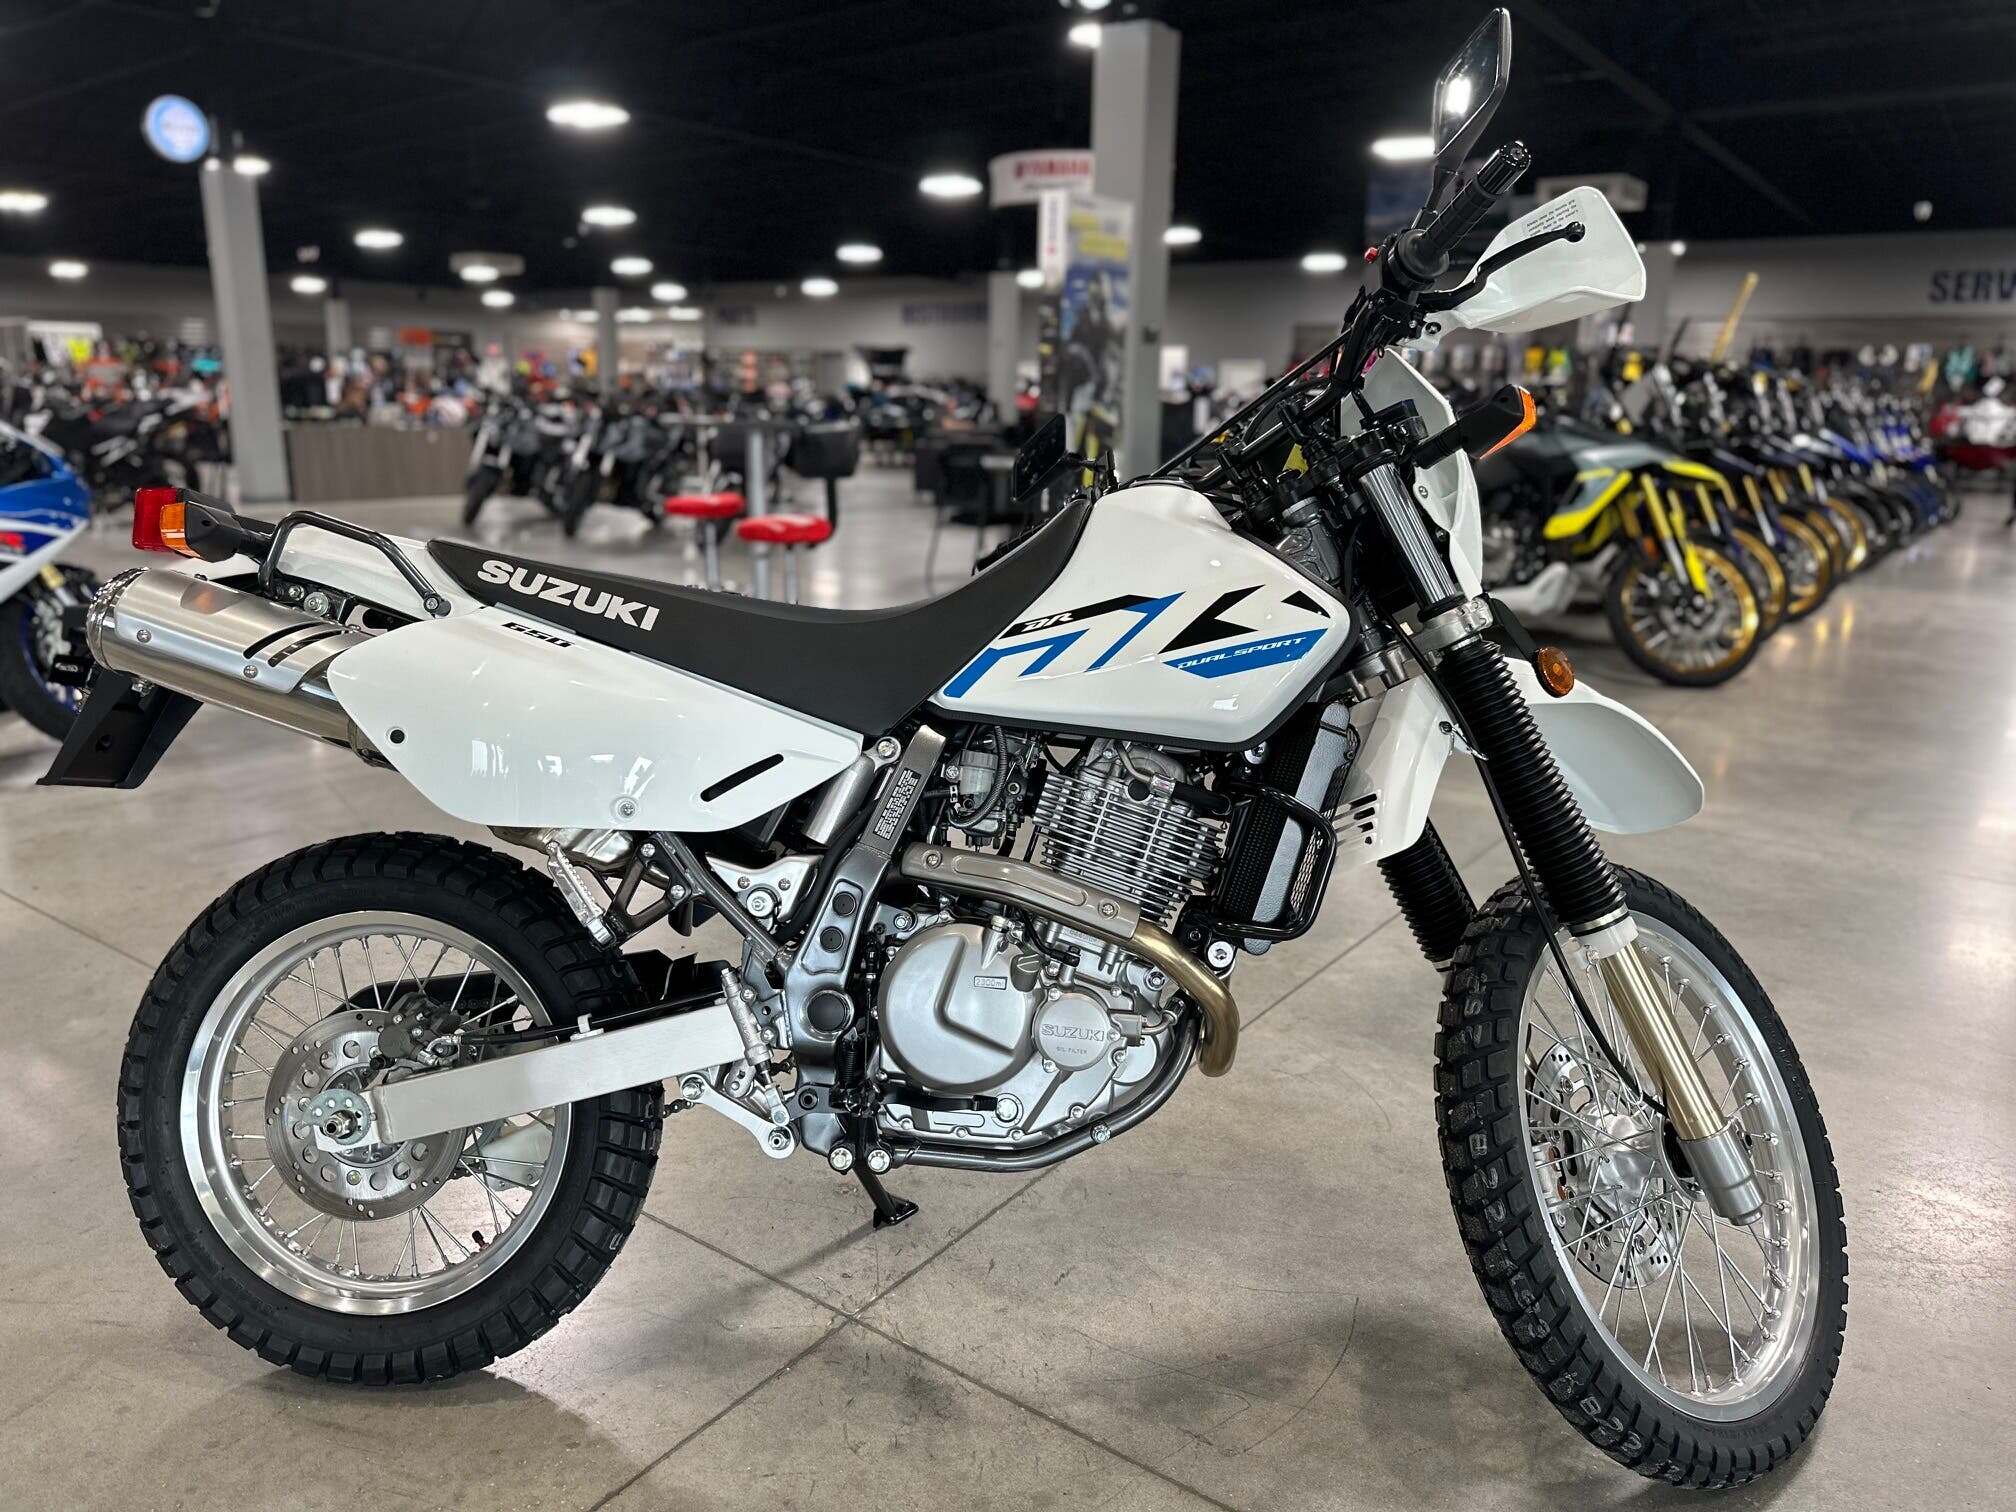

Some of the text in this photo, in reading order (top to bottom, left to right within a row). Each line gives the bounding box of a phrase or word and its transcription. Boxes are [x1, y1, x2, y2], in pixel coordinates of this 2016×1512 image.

[477, 559, 660, 631] SUZUKI
[502, 621, 575, 648] 650
[1041, 1023, 1105, 1042] SUZUKI
